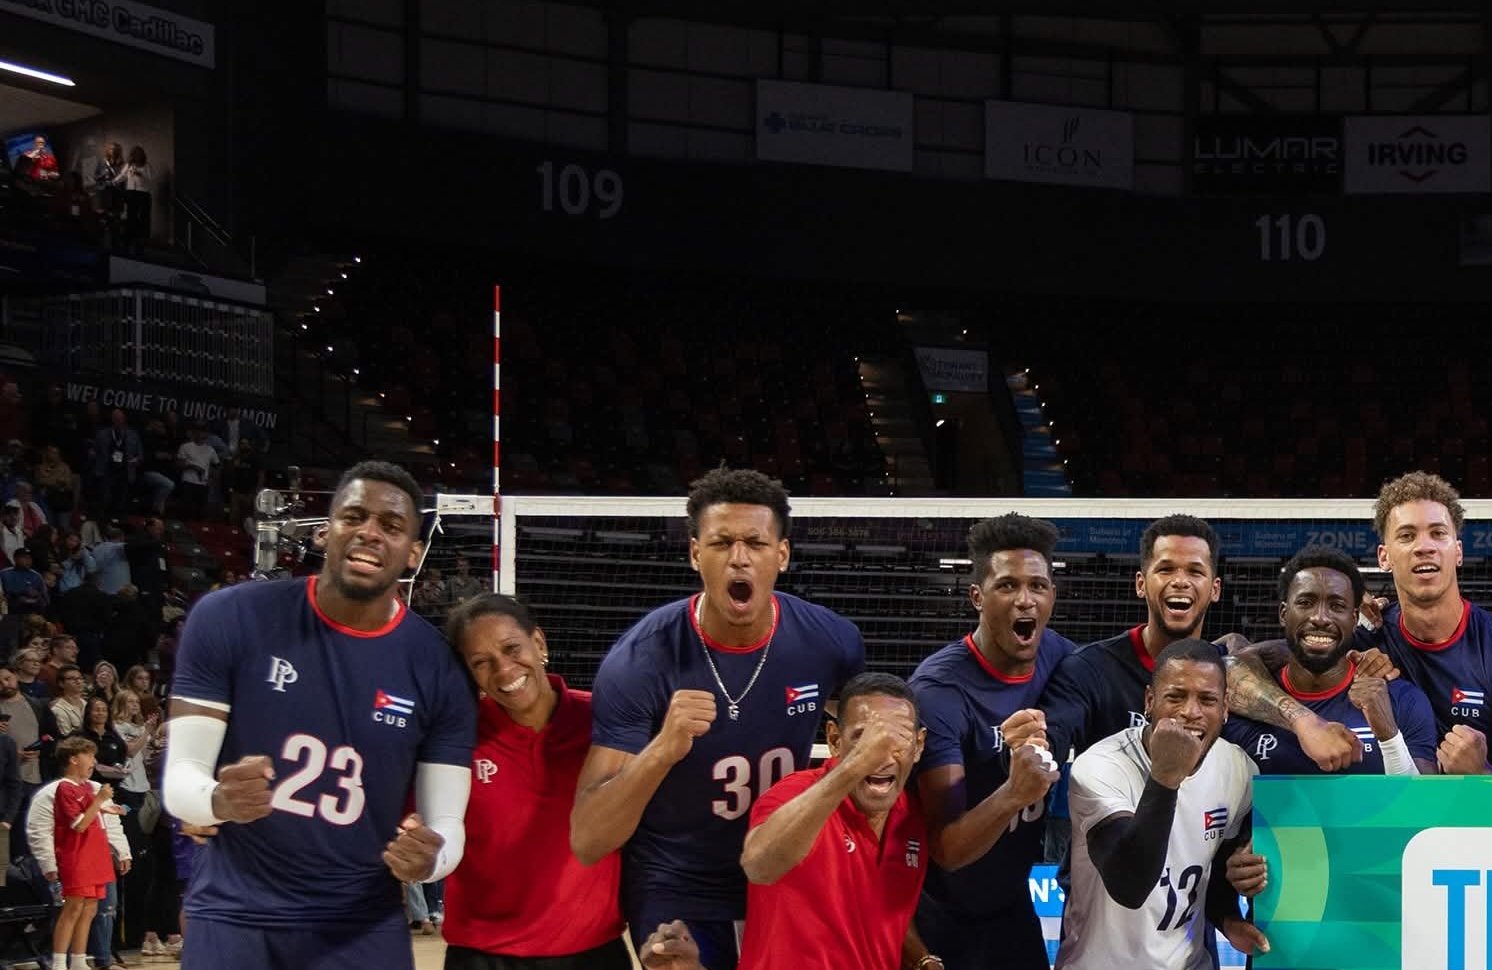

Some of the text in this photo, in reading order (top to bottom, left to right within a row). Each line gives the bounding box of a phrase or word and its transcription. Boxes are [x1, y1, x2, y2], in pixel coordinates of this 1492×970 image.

[112, 6, 204, 56] Cadillac
[1024, 143, 1103, 168] ICON
[1368, 142, 1468, 166] IRVING
[536, 161, 625, 219] 109
[1256, 213, 1326, 262] 110
[184, 400, 278, 429] UNCMON
[1306, 531, 1367, 549] ZONE
[372, 711, 408, 728] CUB
[786, 701, 816, 716] CUB
[1451, 707, 1480, 718] CUB
[270, 733, 366, 826] 23
[1157, 865, 1204, 931] 12
